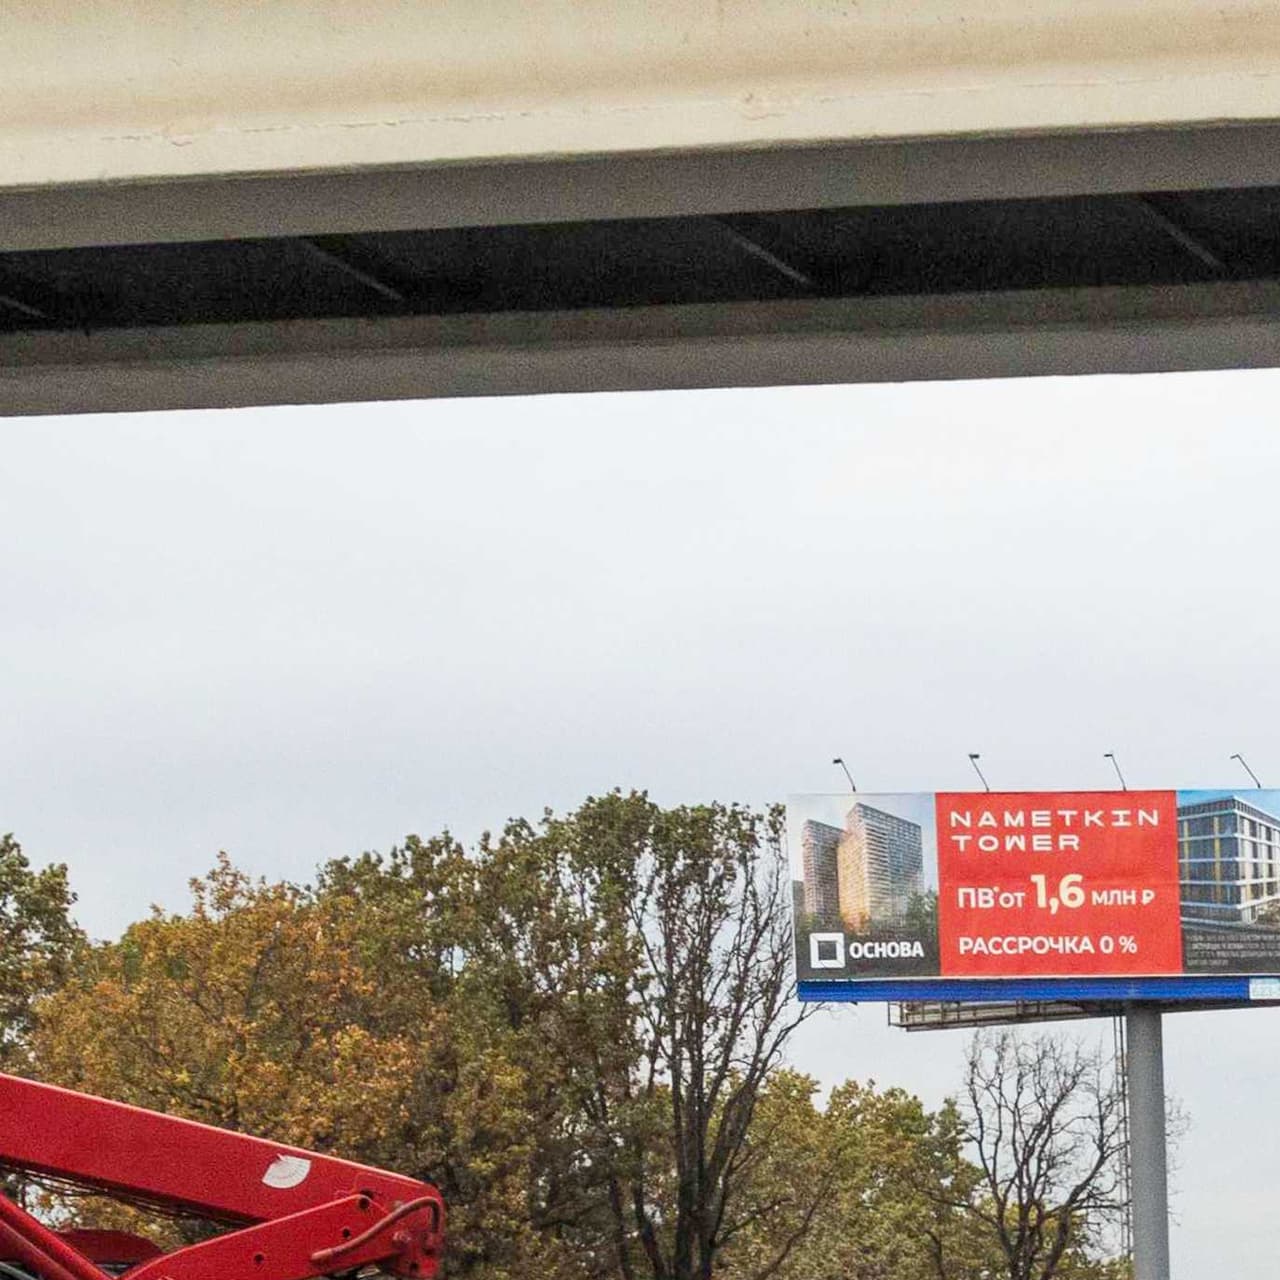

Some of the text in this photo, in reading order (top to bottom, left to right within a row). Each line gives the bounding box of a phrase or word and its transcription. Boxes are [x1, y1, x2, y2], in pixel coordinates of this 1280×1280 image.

[950, 809, 1159, 828] NAMETKIN
[950, 834, 1081, 852] TOWER
[1030, 873, 1086, 915] 1,6
[848, 941, 925, 959] ОСНОВА
[958, 934, 1138, 955] РАССРОЧКА 0 %
